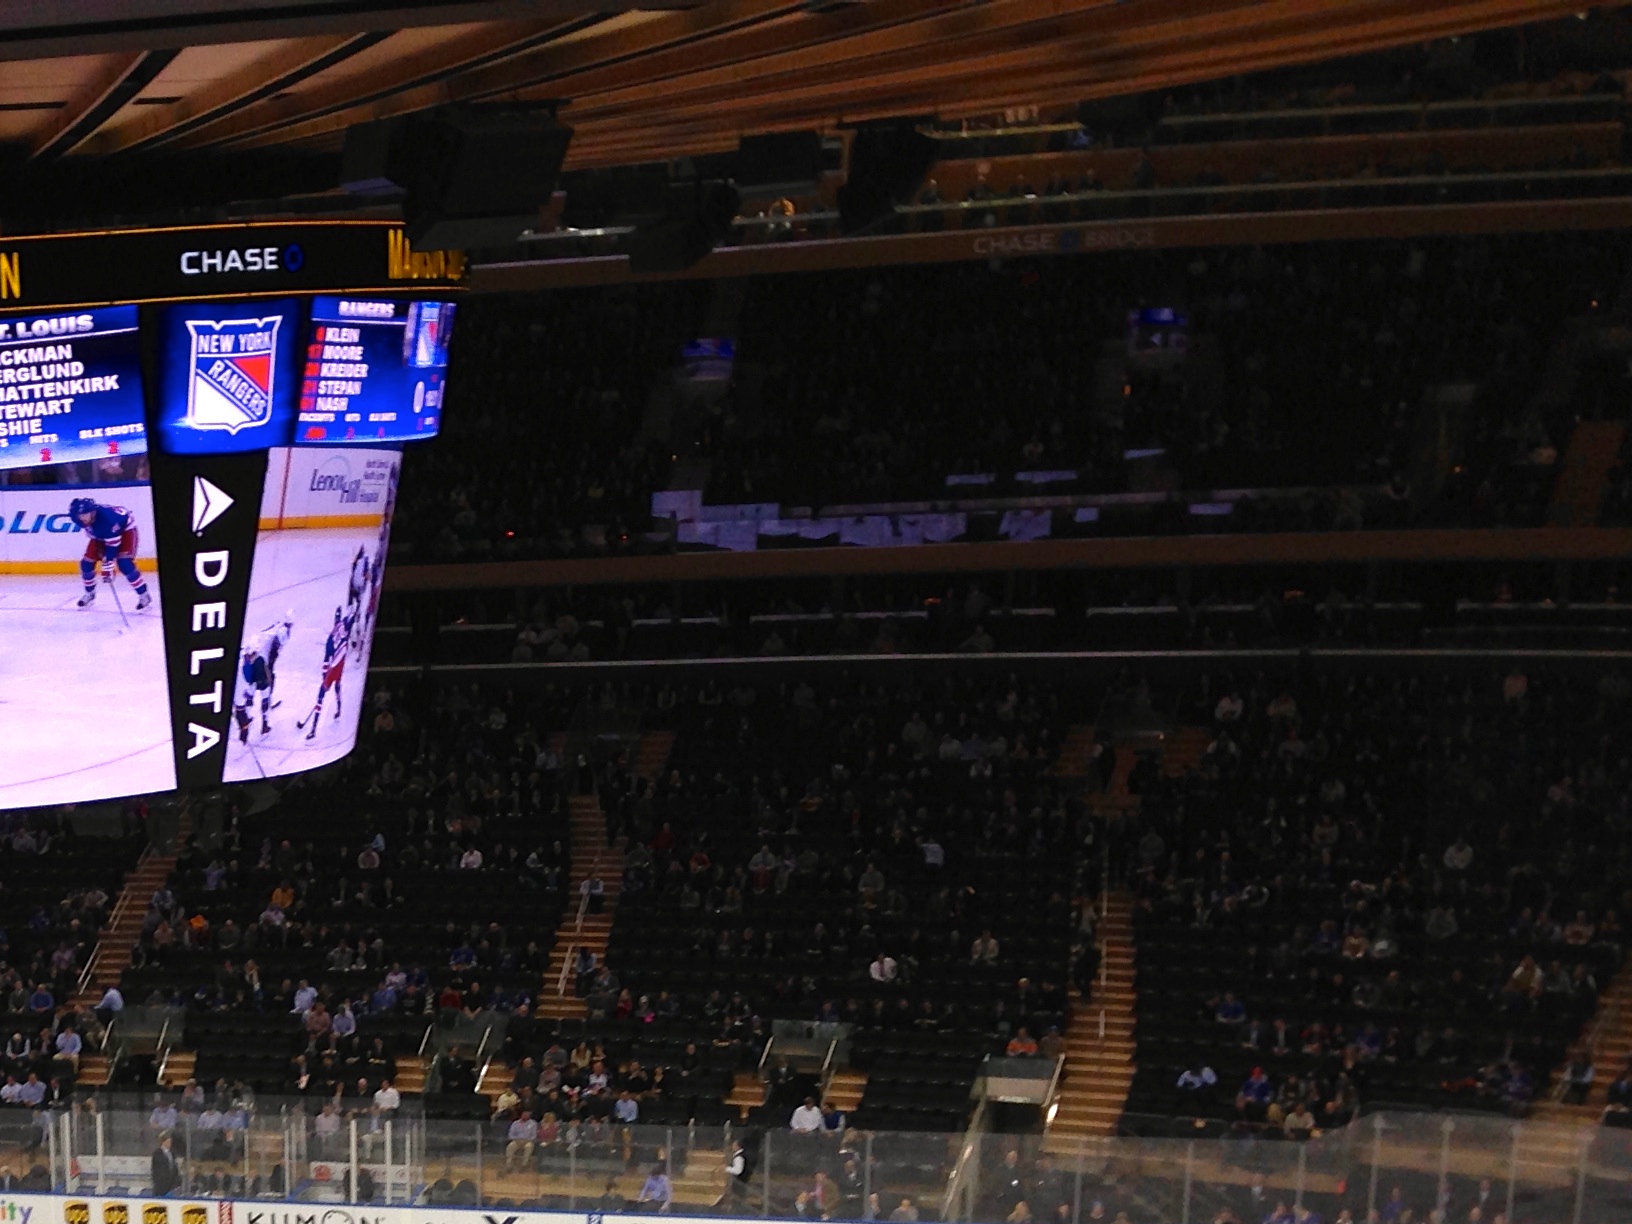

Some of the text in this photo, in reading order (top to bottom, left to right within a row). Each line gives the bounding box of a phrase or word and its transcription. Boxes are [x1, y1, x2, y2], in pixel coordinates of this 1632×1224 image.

[180, 247, 279, 274] CHASE
[15, 314, 94, 338] LOUIS
[197, 331, 271, 353] NEW YORK
[208, 359, 267, 416] RANGERS
[29, 434, 59, 445] HITS
[186, 550, 229, 760] DELTA
